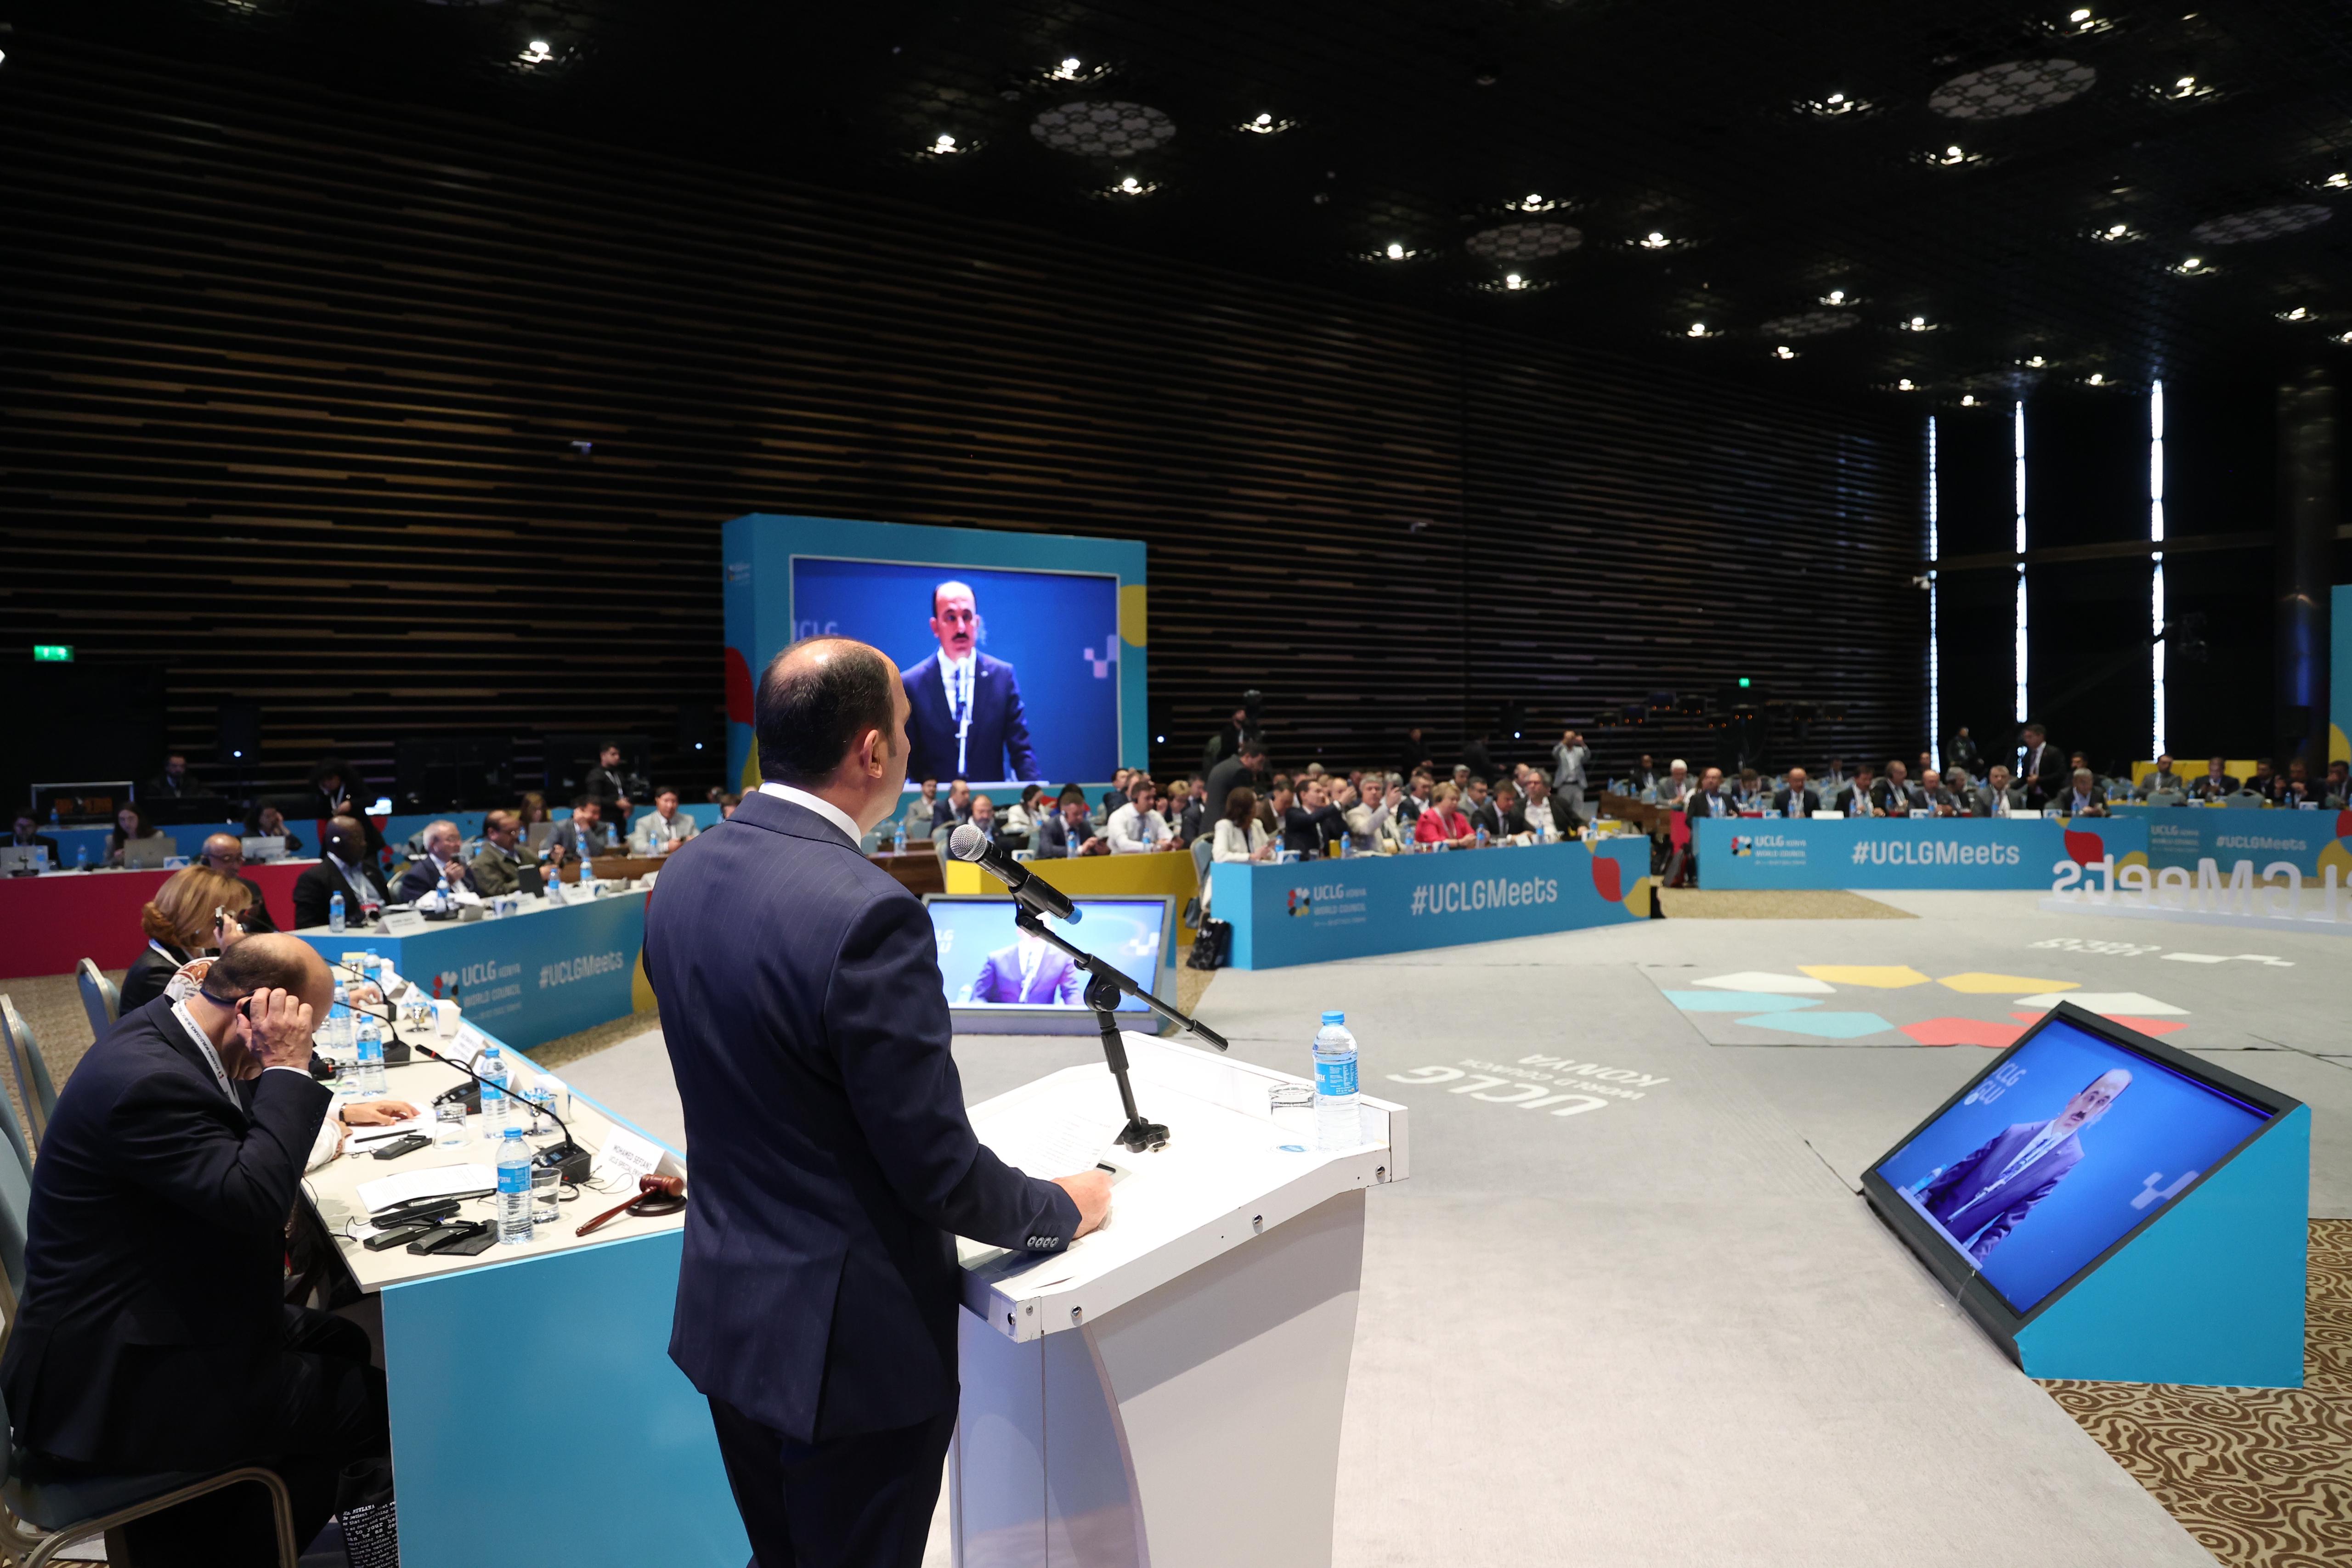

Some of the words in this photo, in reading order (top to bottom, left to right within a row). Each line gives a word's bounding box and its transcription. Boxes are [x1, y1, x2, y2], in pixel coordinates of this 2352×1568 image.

[1755, 835, 1784, 847] UCLG
[1852, 841, 2020, 865] #UCLGMeets
[1313, 883, 1344, 901] UCLG
[1411, 877, 1557, 916] #UCLGMeets
[462, 960, 497, 987] UCLG
[539, 951, 624, 989] #UCLGMeets
[1516, 1053, 1670, 1087] KONYA
[1385, 1065, 1609, 1117] UCLG
[350, 1512, 368, 1520] patient
[352, 1504, 375, 1514] MEVLANA
[362, 1510, 389, 1522] everything
[367, 1522, 384, 1532] your
[373, 1540, 392, 1550] patient
